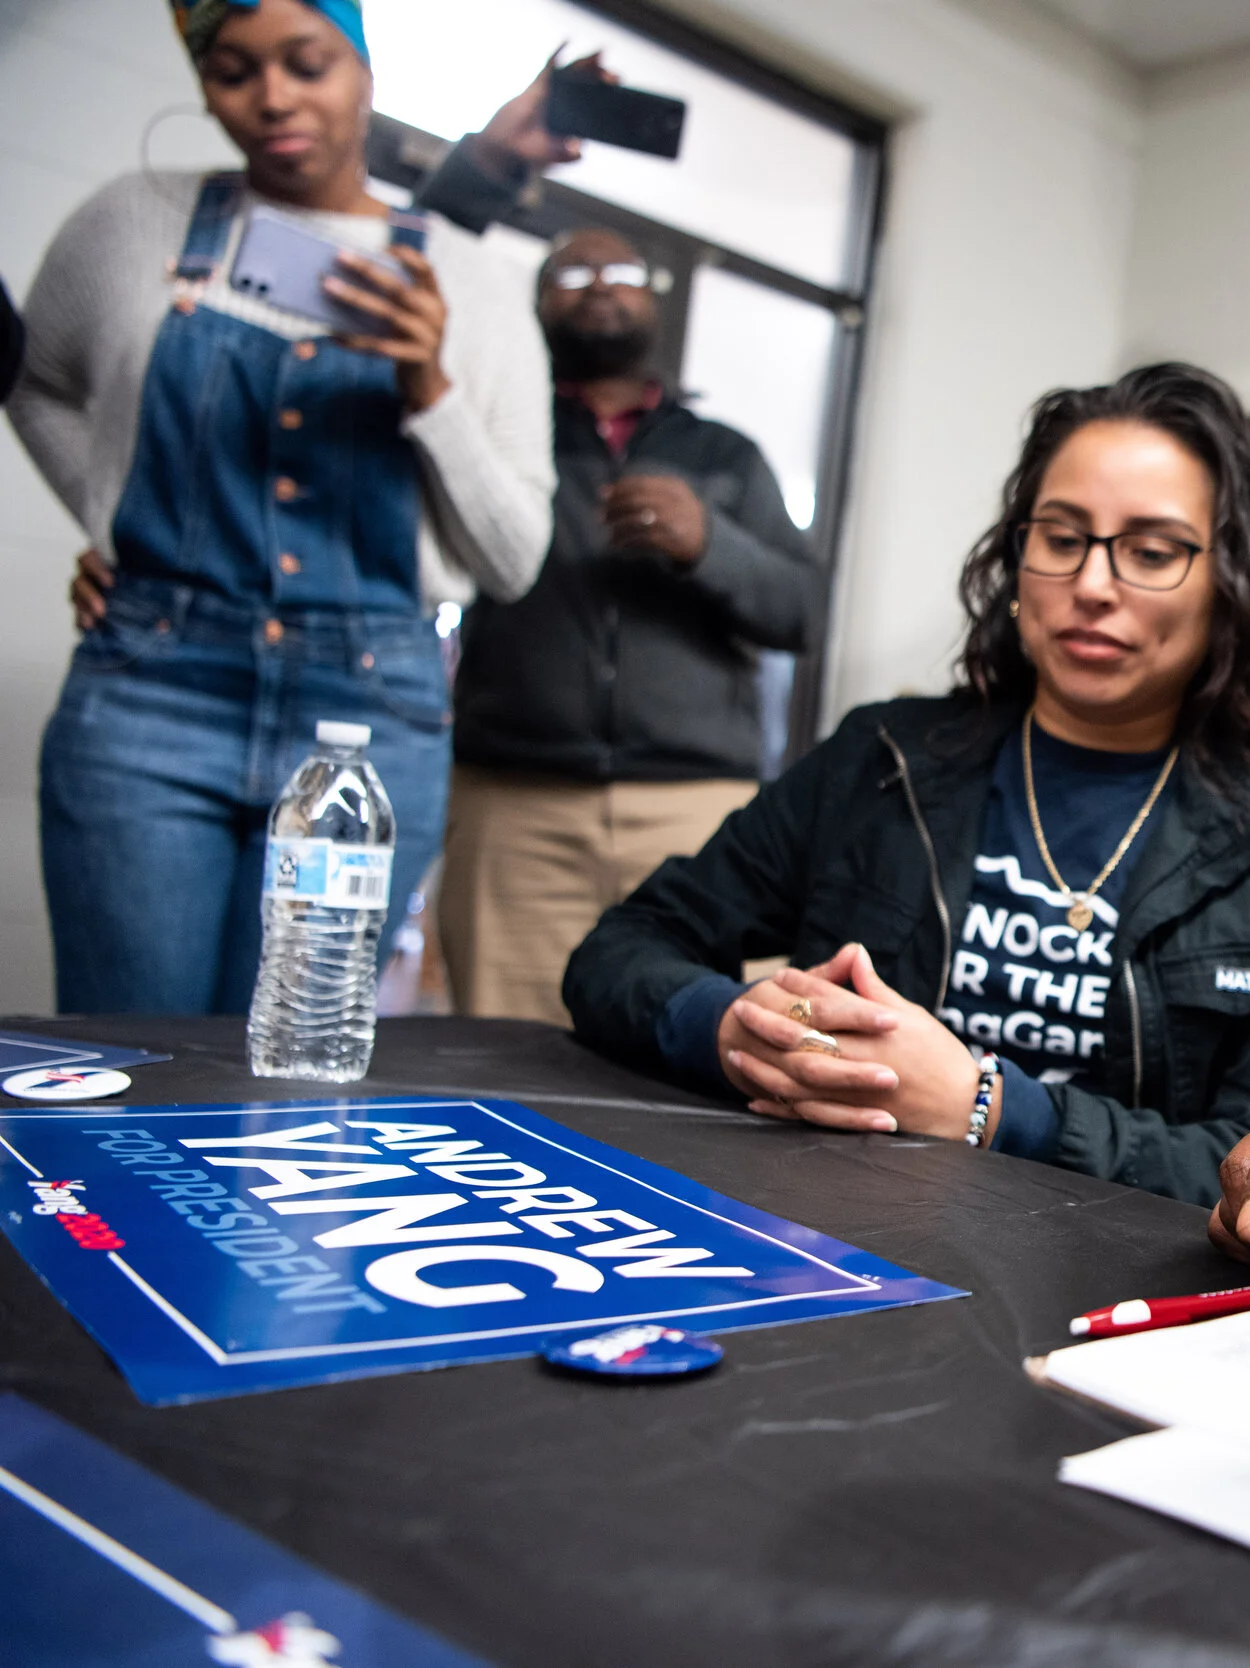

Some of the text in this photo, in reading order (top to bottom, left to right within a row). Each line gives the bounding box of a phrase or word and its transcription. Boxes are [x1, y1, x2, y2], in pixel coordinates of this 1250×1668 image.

[963, 901, 1116, 967] NOCK
[1001, 961, 1111, 1020] THE
[82, 1129, 388, 1314] FOR PRESIDENT
[177, 1121, 605, 1308] YANG
[344, 1120, 756, 1278] ANDREW
